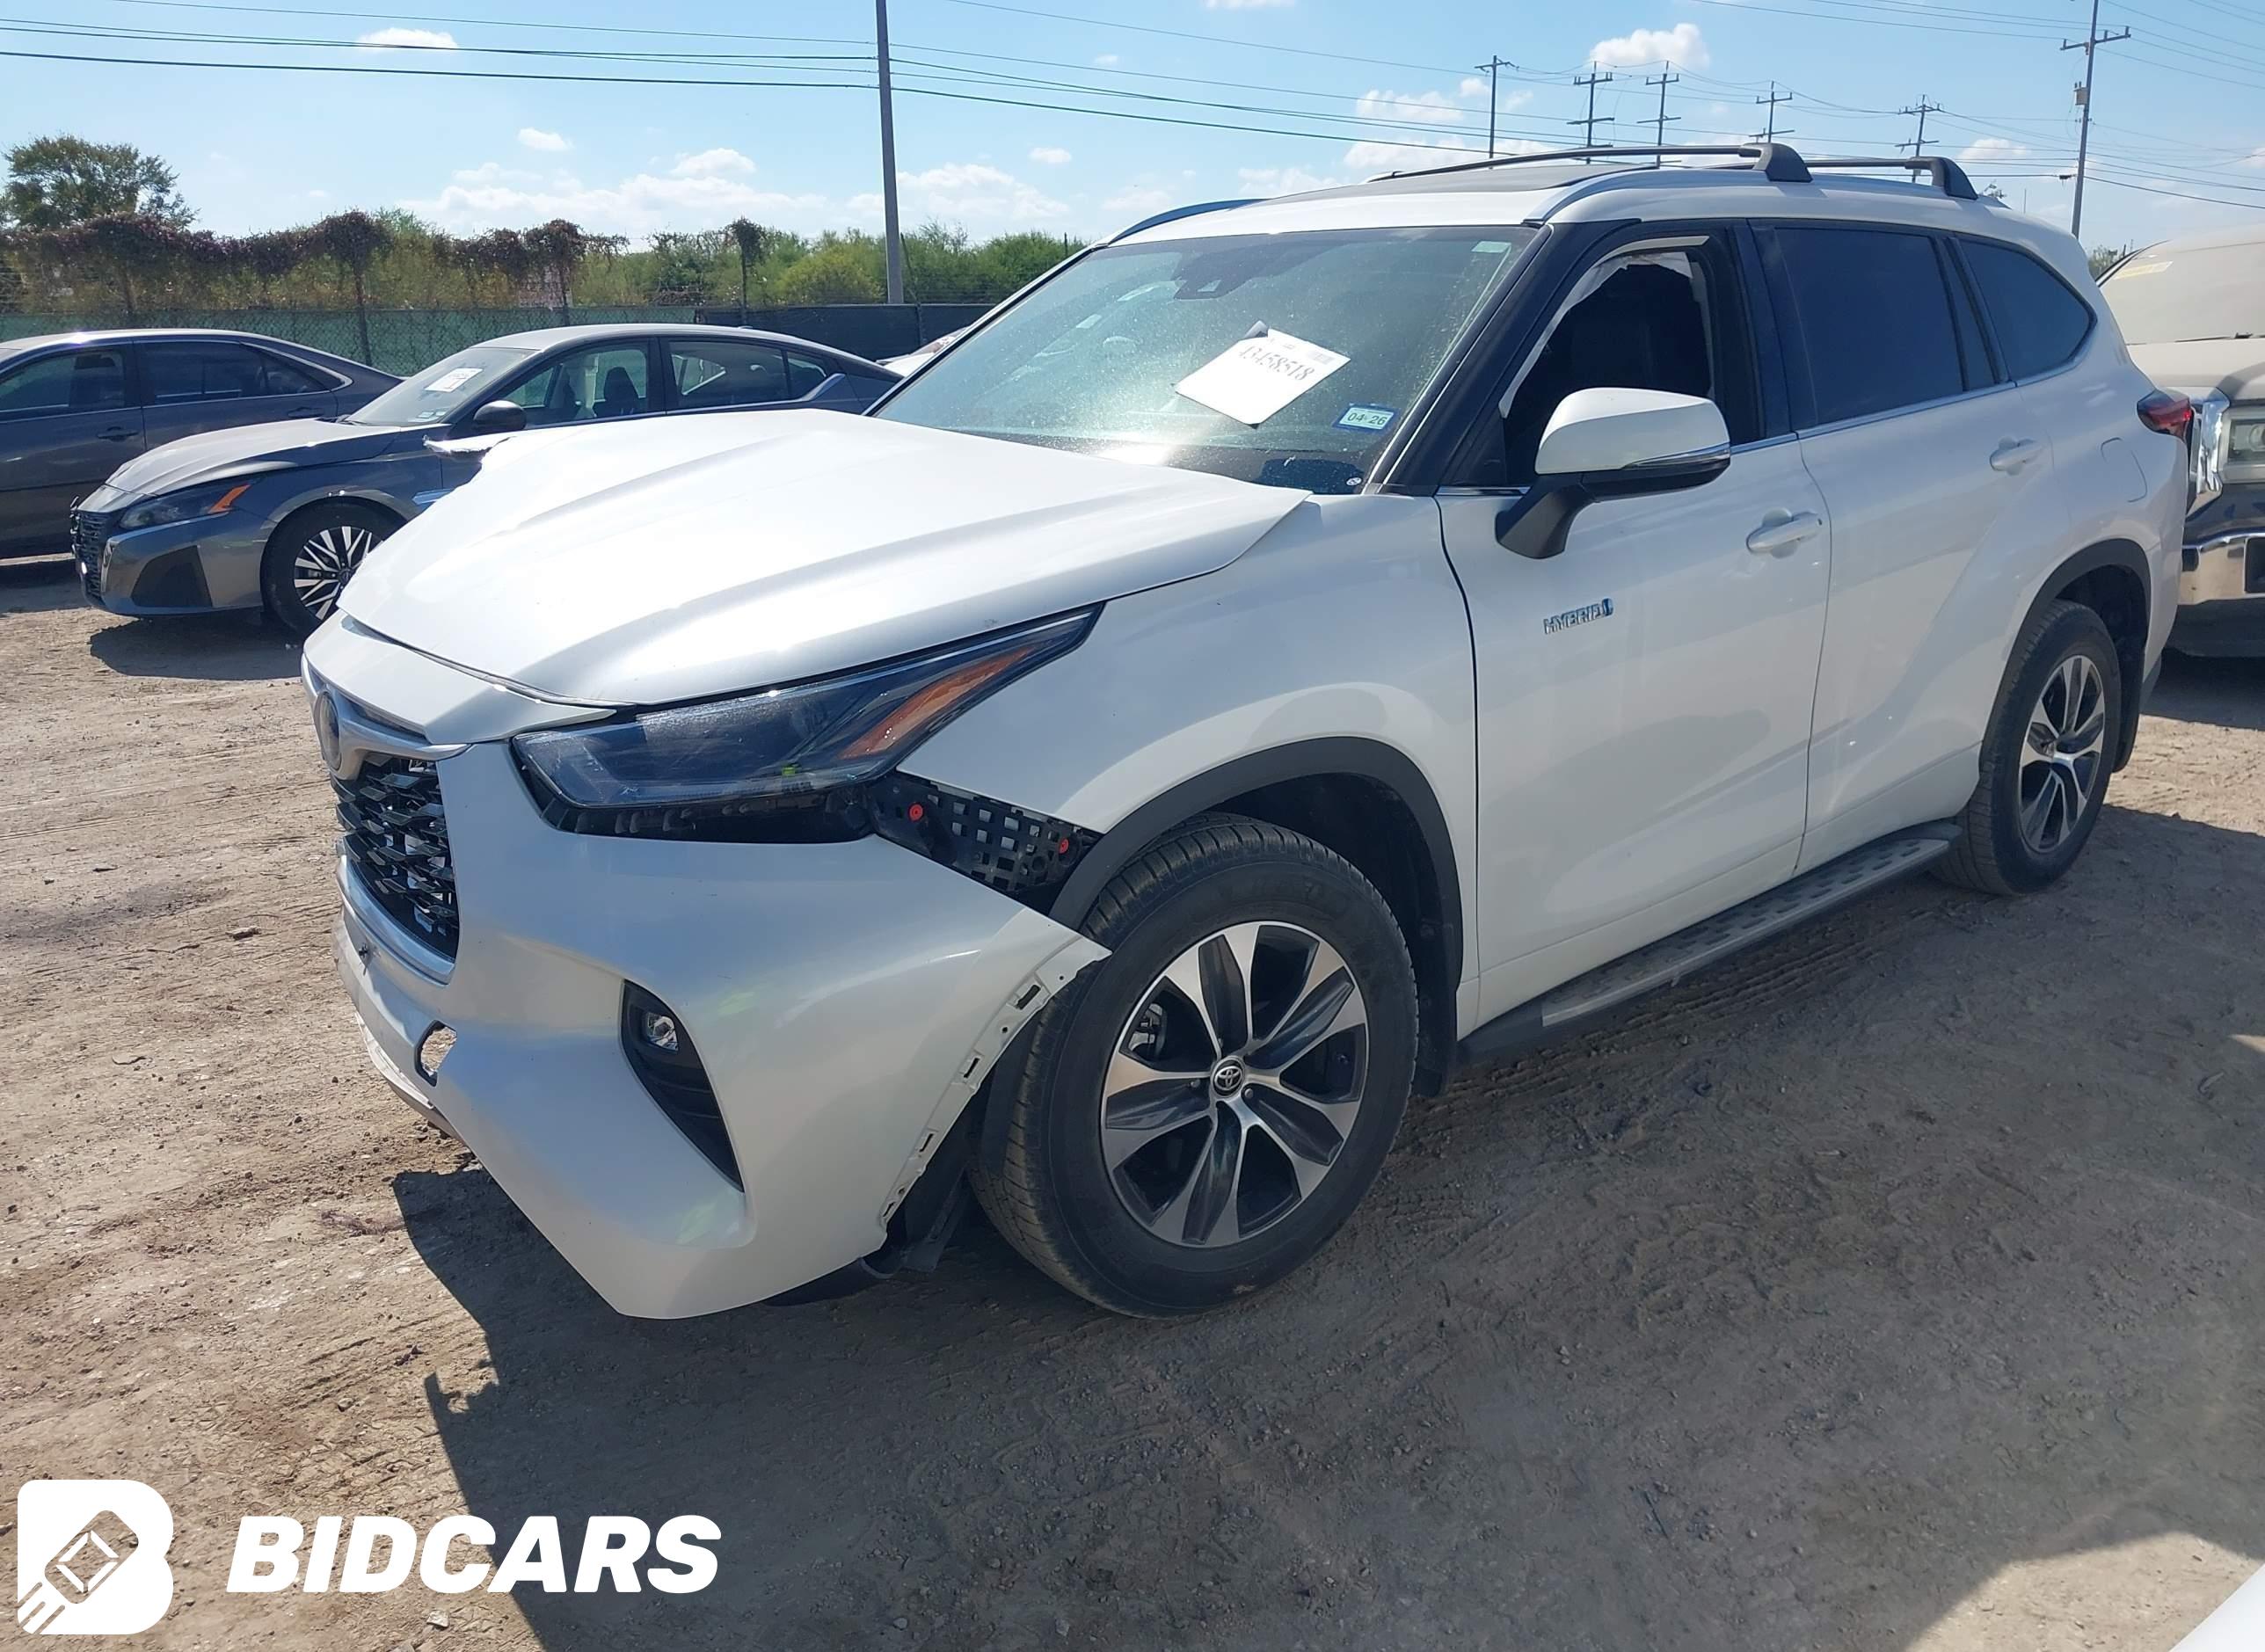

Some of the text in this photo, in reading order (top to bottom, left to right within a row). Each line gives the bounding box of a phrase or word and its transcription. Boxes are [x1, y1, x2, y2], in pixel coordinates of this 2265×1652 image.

[1347, 412, 1387, 426] 04 26
[1543, 603, 1601, 634] HYBRID
